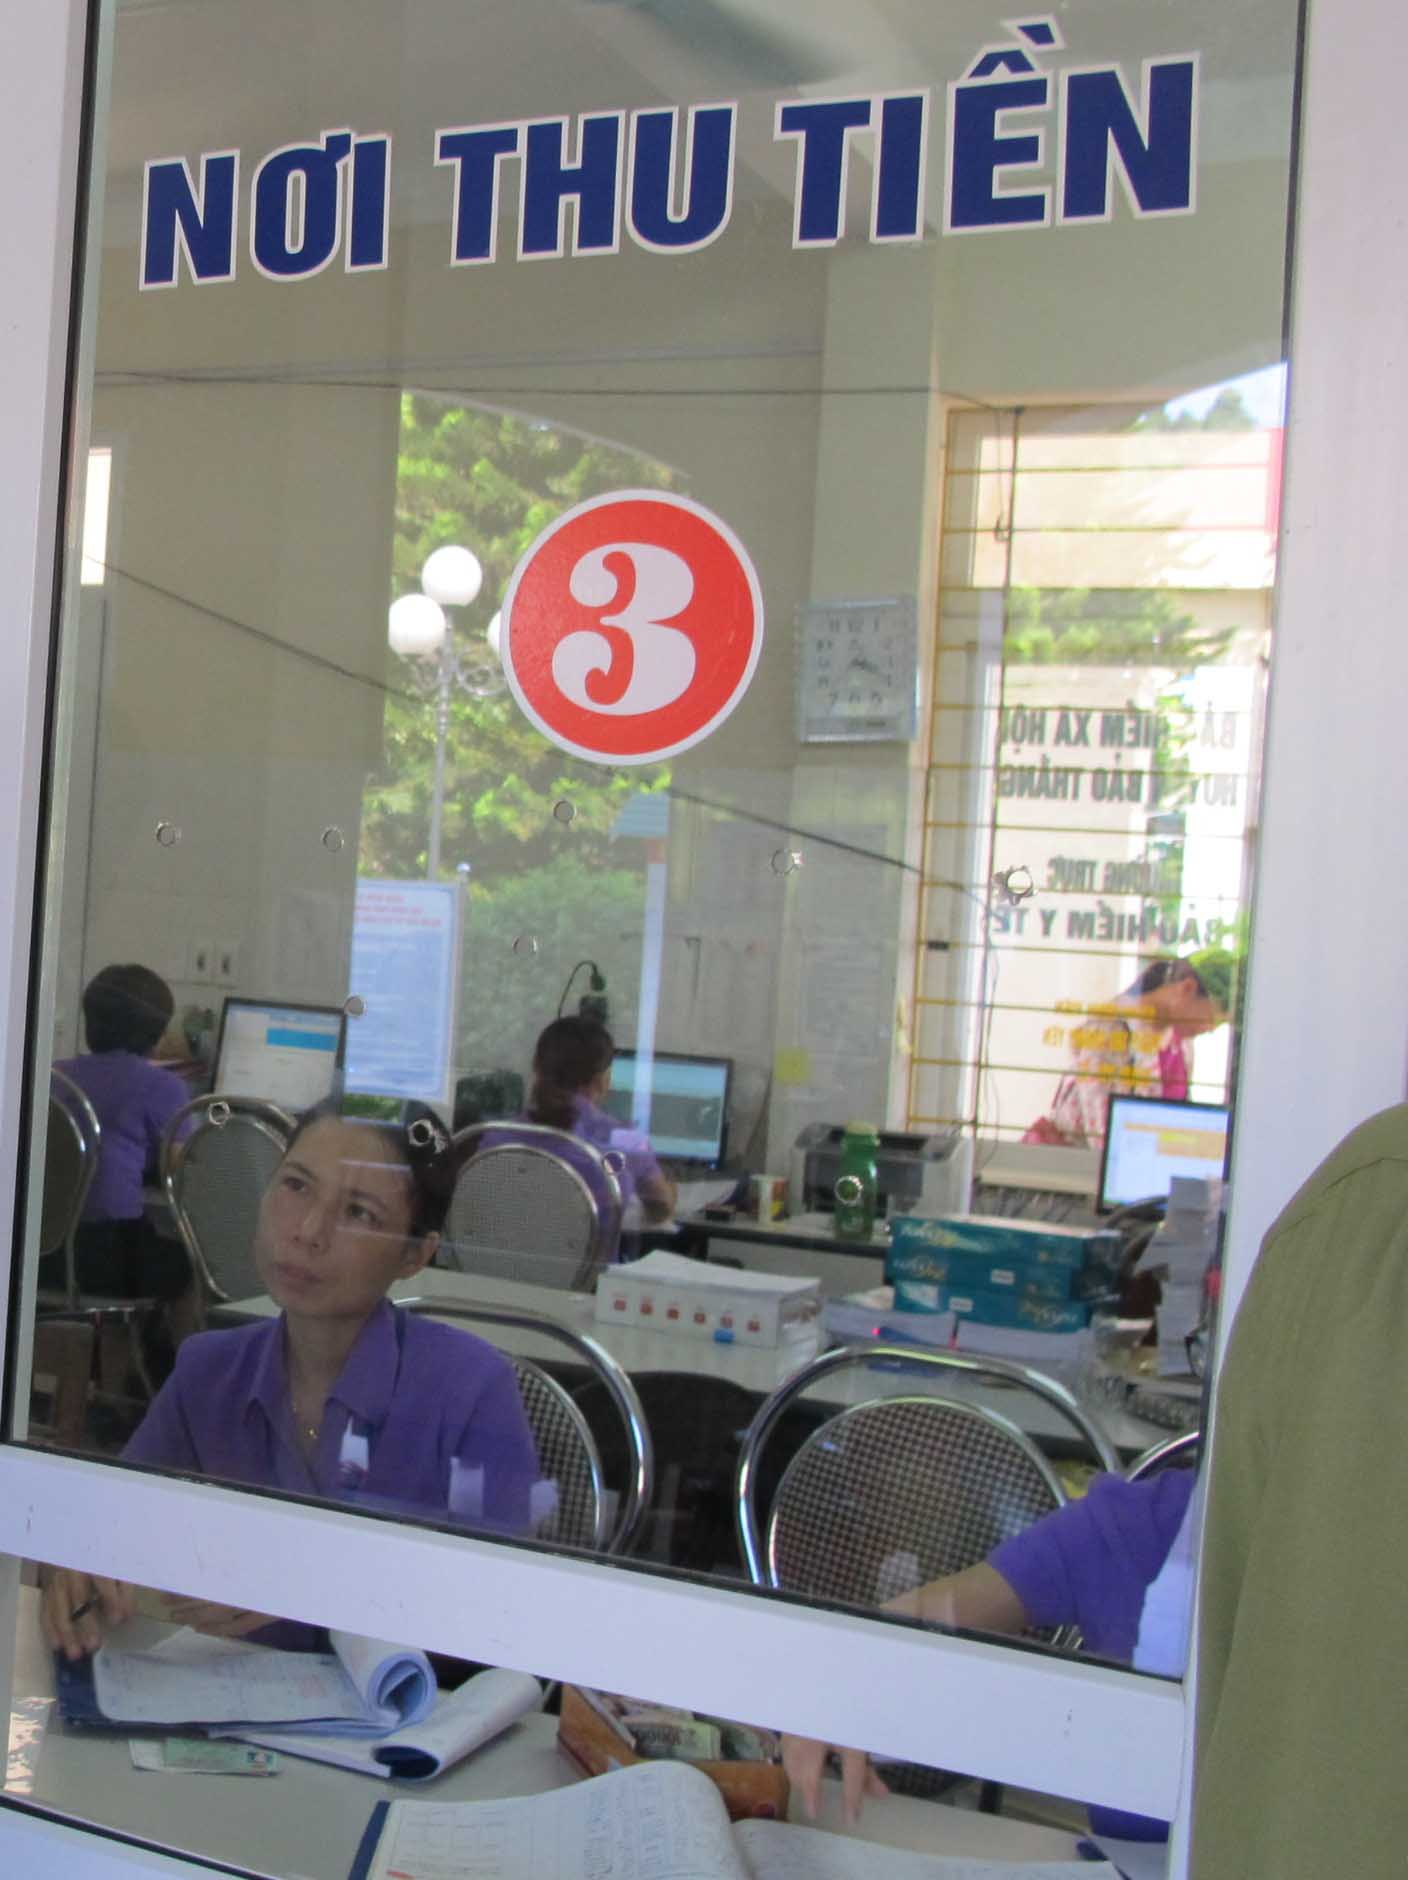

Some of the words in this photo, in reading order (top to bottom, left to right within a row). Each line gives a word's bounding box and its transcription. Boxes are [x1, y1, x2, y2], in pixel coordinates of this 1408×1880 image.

[139, 127, 391, 290] NƠI
[433, 101, 739, 266] THU
[773, 16, 1200, 248] TIỀN
[551, 541, 696, 716] 3
